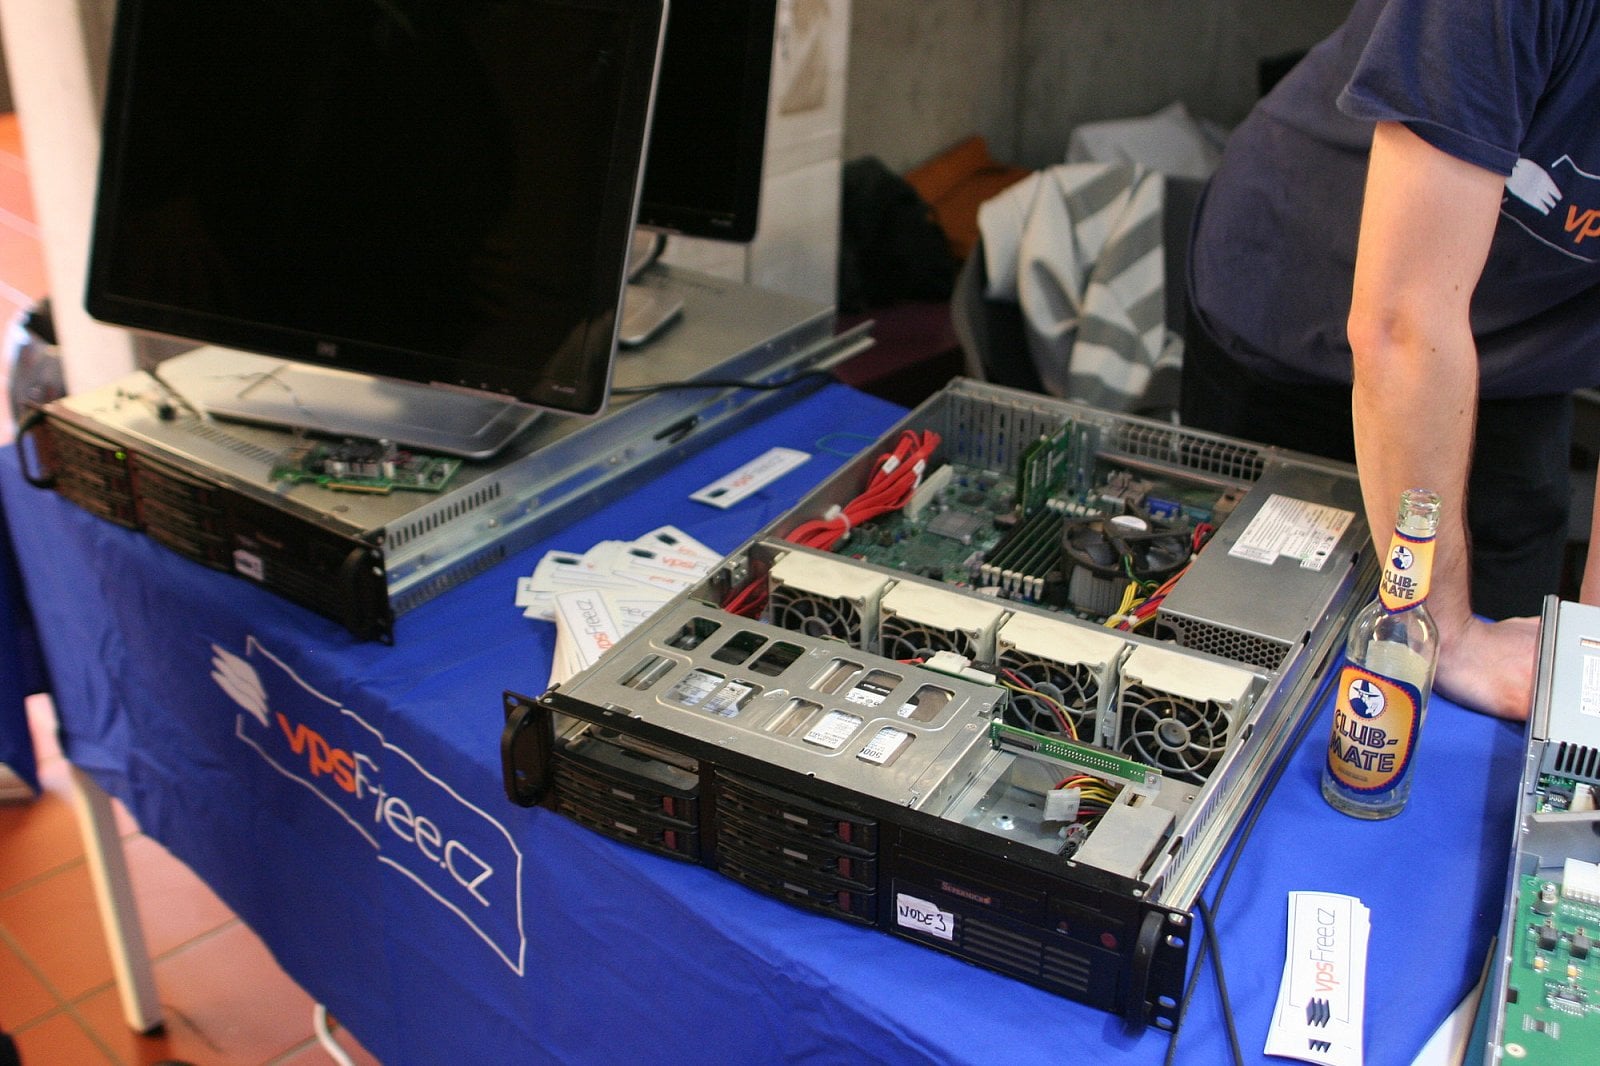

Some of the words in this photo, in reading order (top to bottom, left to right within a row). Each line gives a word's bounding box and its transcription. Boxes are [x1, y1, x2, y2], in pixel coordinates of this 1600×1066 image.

[1381, 579, 1414, 600] MATE
[1385, 569, 1418, 588] CLUB-
[1335, 708, 1398, 749] CLUB-
[1330, 731, 1396, 773] MATE
[276, 711, 493, 907] vpsFree.cz
[1309, 907, 1341, 992] vpsFree.cz
